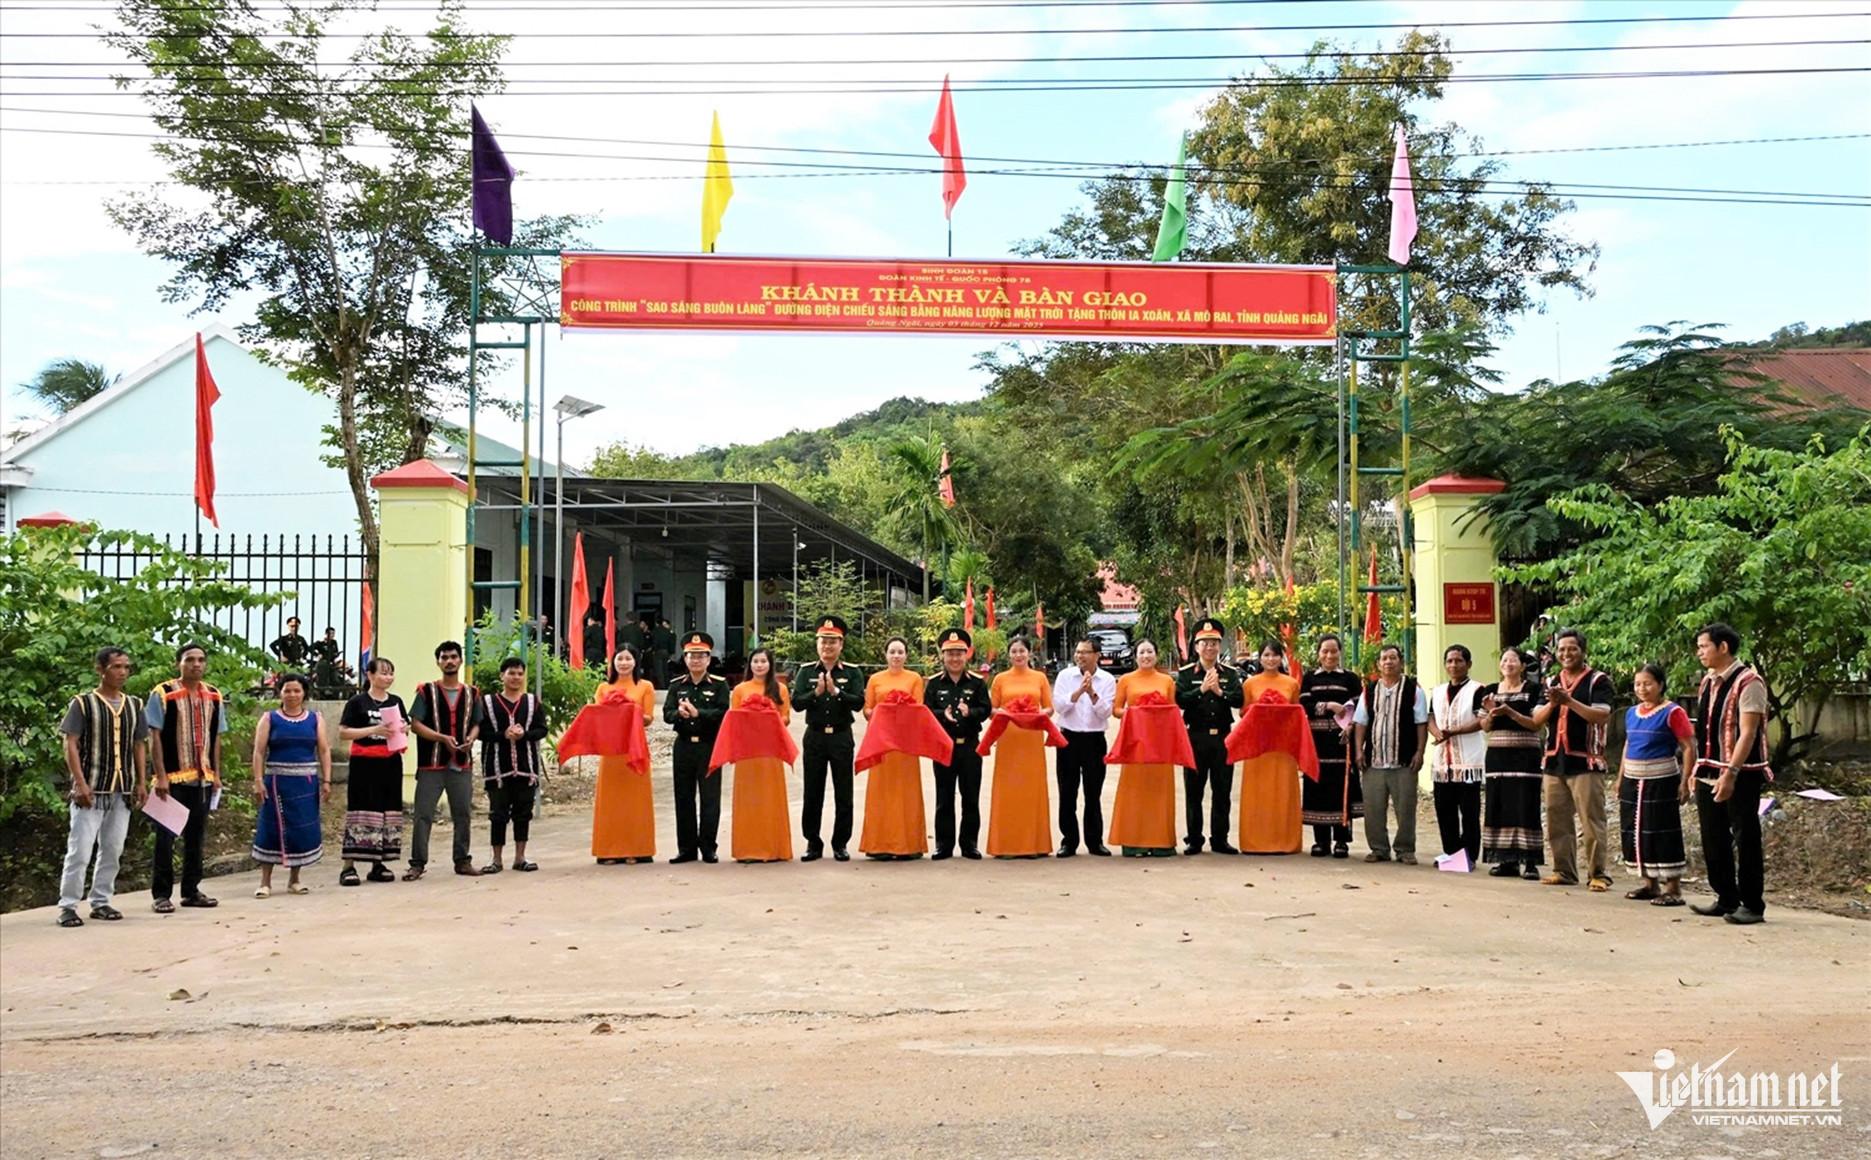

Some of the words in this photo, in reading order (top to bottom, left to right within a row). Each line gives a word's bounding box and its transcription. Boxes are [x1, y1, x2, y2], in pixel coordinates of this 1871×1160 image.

[760, 283, 860, 301] KHÁNH
[868, 285, 964, 303] THÀNH
[973, 286, 1011, 304] VÀ
[1019, 287, 1074, 305] BÀN
[1082, 291, 1147, 306] GIAO
[570, 298, 602, 312] CÔNG
[604, 299, 637, 313] TRÌNH
[670, 300, 701, 314] SÁNG
[704, 300, 734, 315] BUÔN
[843, 302, 875, 316] CHIẾU
[878, 303, 908, 317] SÁNG
[910, 303, 941, 318] BẰNG
[943, 304, 974, 319] NĂNG
[976, 305, 1011, 321] LƯỢNG
[1013, 305, 1037, 322] MẶT
[1040, 306, 1064, 320] TRỜI
[1067, 306, 1096, 322] TẶNG
[1098, 307, 1126, 321] THÔN
[1128, 309, 1140, 321] IA
[1213, 311, 1234, 324] RAI,
[1236, 308, 1261, 324] TỈNH
[1263, 310, 1300, 325] QUẢNG
[1301, 311, 1328, 325] NGÃI
[960, 320, 986, 329] tháng
